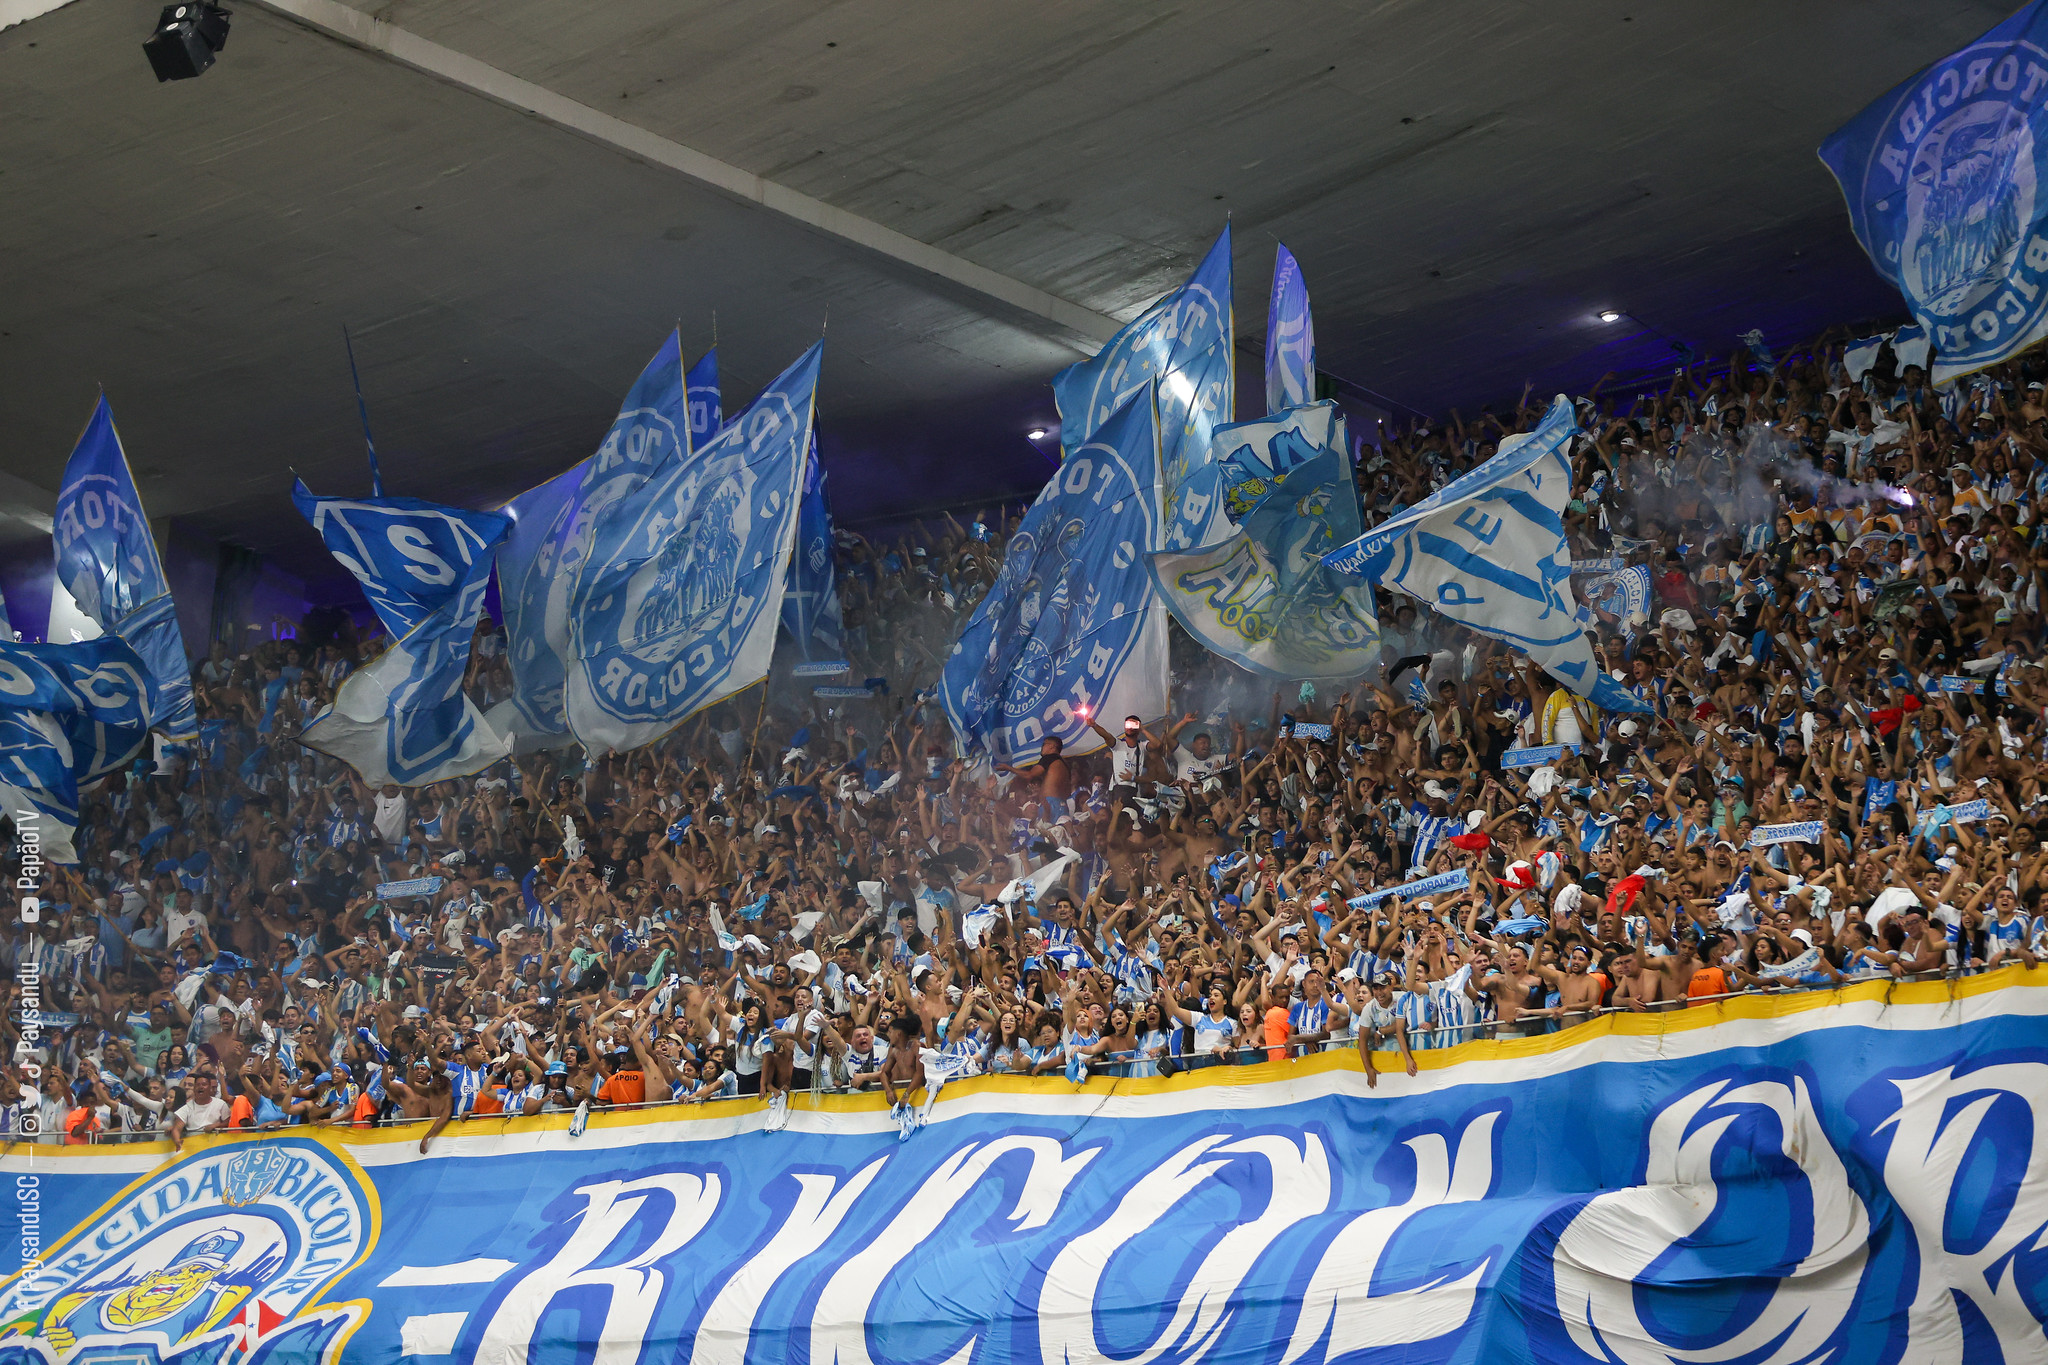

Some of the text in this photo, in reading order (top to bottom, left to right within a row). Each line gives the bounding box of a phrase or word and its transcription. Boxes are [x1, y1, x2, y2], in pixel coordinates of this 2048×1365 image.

[1355, 898, 1371, 909] VAI
[1414, 874, 1461, 894] CARALHO
[614, 1074, 639, 1082] APOIO
[0, 1156, 354, 1320] TORCIDA BICOLOR
